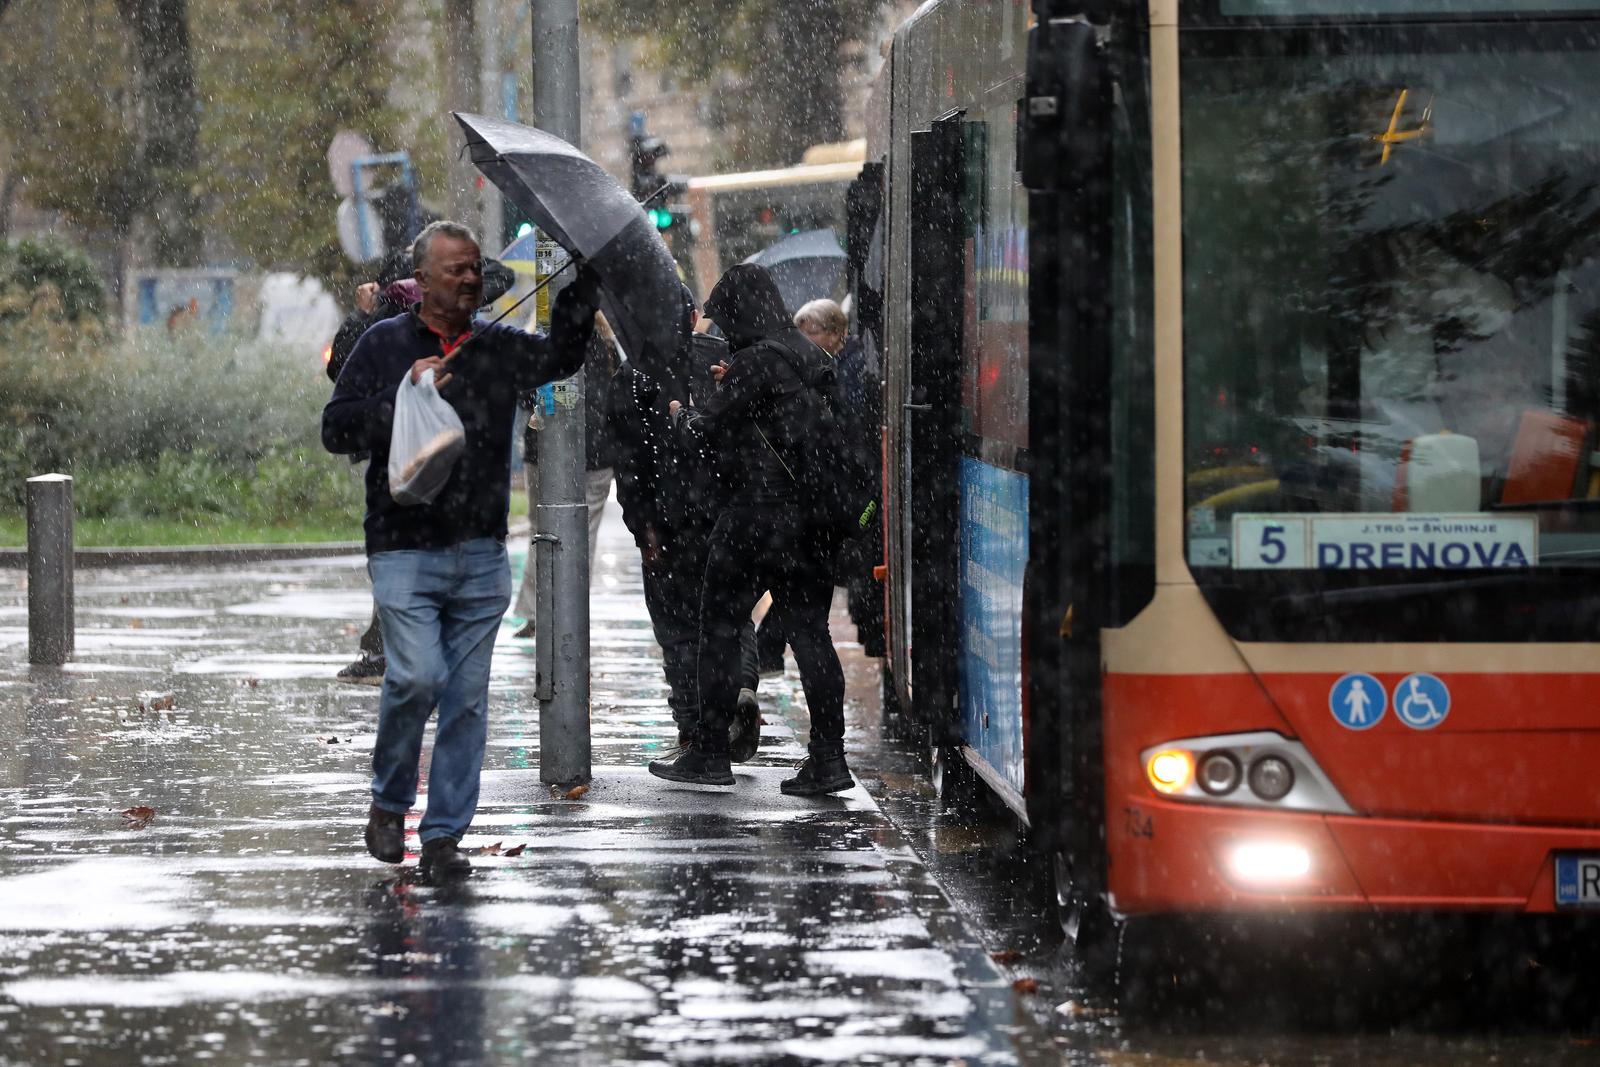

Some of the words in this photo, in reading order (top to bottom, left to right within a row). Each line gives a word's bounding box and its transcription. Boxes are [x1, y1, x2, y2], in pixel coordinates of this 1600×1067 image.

[1423, 522, 1498, 533] ŠKURINJE
[1259, 525, 1286, 565] 5
[1317, 542, 1529, 569] DRENOVA
